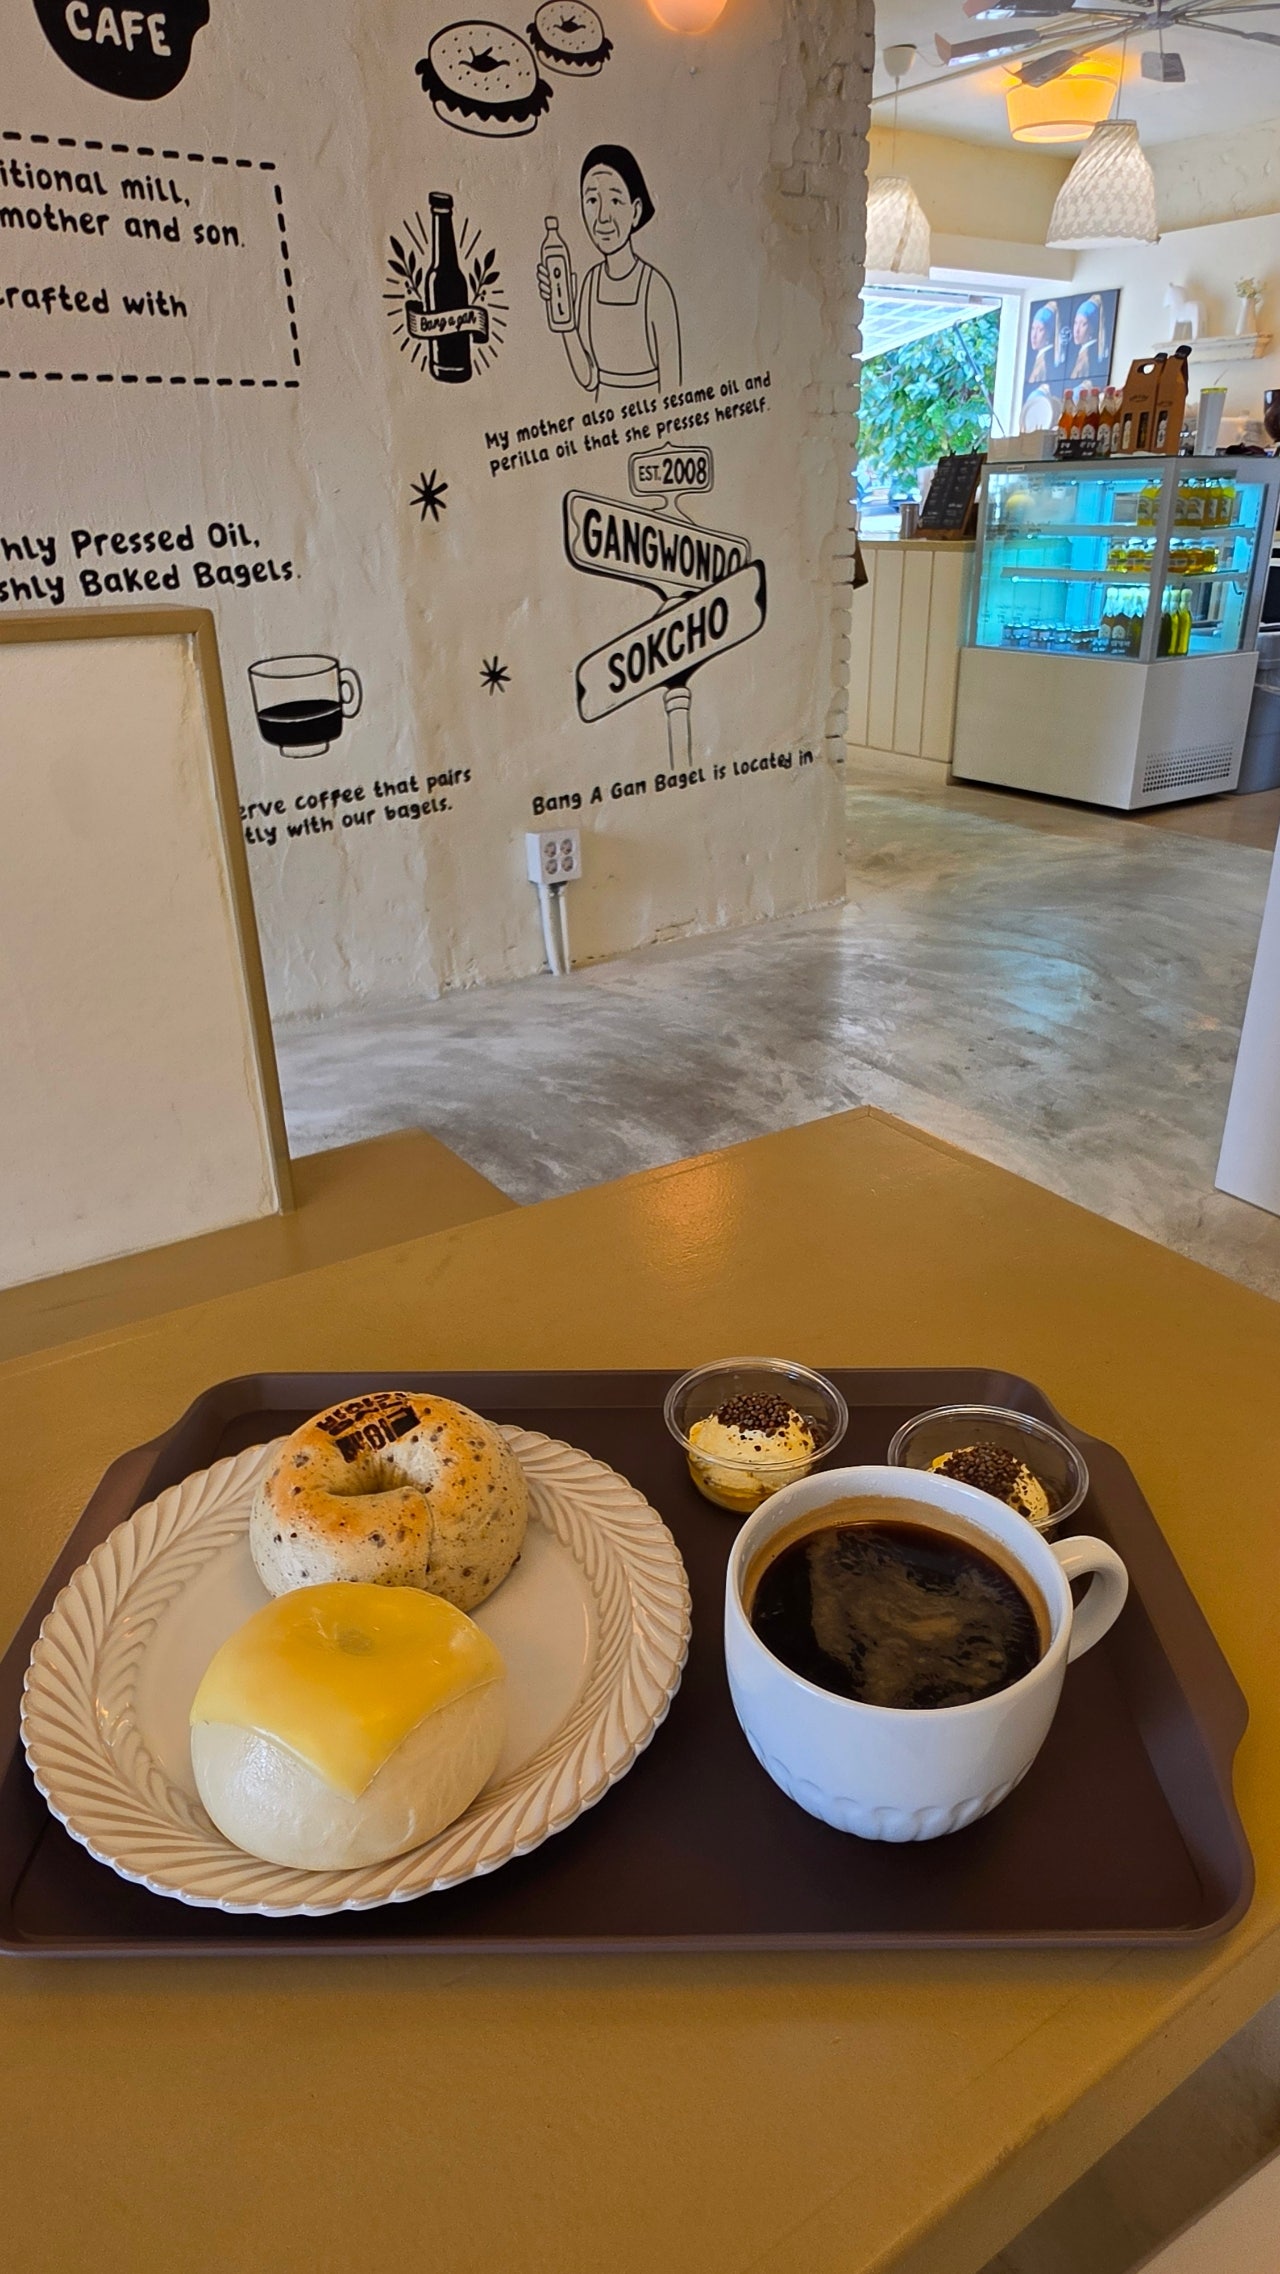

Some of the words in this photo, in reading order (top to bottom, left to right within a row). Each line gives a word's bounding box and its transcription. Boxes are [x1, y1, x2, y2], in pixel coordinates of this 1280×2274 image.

[65, 1, 172, 56] CAFE
[121, 175, 189, 207] mill,
[0, 203, 109, 236] mother
[125, 217, 180, 242] and
[194, 224, 244, 247] son.
[0, 285, 109, 314] rafted
[123, 290, 187, 317] with
[485, 431, 509, 450] My
[517, 417, 574, 444] mother
[582, 409, 614, 426] also
[621, 399, 656, 419] sells
[663, 387, 715, 409] sesame
[720, 380, 739, 396] oil
[745, 371, 770, 390] and
[490, 449, 549, 477] perilla
[556, 441, 577, 458] oil
[584, 429, 619, 451] that
[626, 425, 650, 442] she
[657, 412, 709, 439] presses
[715, 396, 770, 421] herself.
[638, 465, 661, 481] EST.
[662, 457, 707, 484] 2008
[0, 536, 56, 566] hly
[71, 525, 194, 559] Pressed
[208, 523, 259, 548] Oil,
[79, 564, 180, 596] Baked
[193, 560, 301, 588] Bagels.
[608, 597, 728, 693] SOKCHO
[295, 787, 365, 810] coffee
[374, 776, 419, 797] that
[427, 769, 471, 793] pairs
[533, 793, 581, 815] Bang
[590, 786, 602, 804] A
[611, 781, 646, 799] Gan
[655, 769, 705, 792] Bagel
[714, 765, 726, 780] is
[733, 753, 792, 775] located
[799, 751, 813, 766] in
[245, 827, 276, 846] tly
[287, 816, 333, 837] with
[342, 810, 375, 827] our
[384, 798, 452, 820] bagels.
